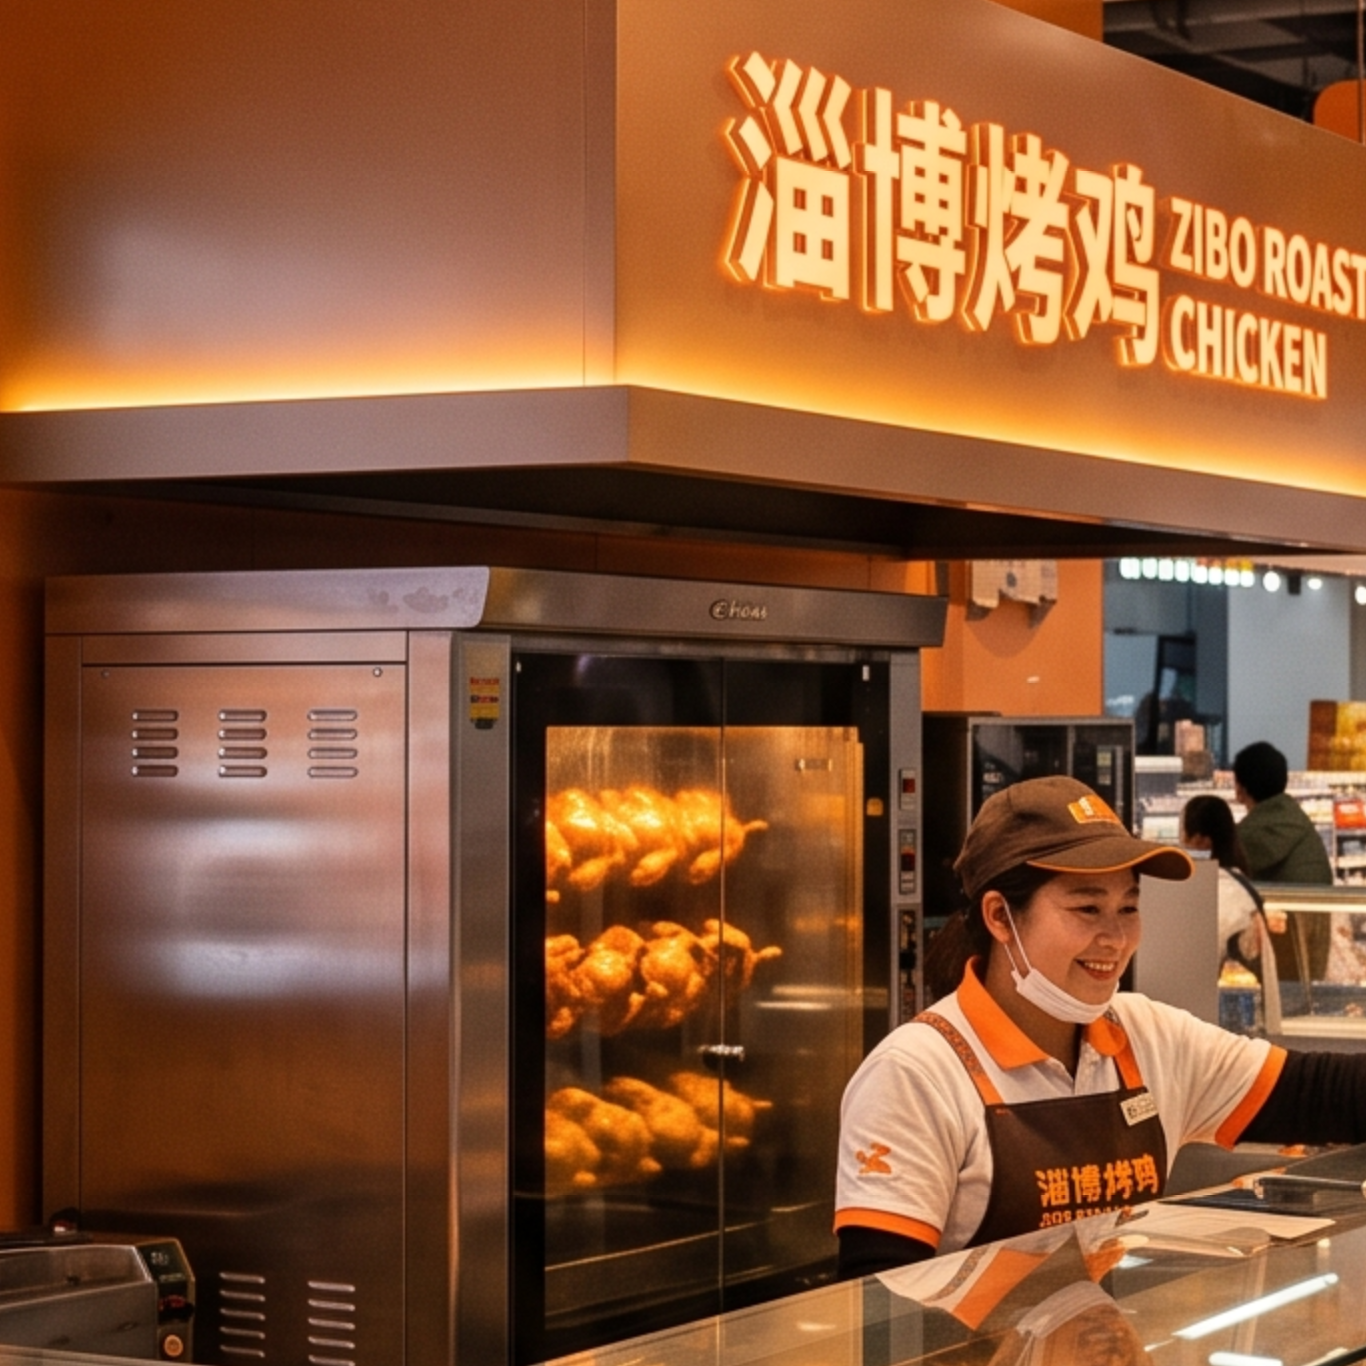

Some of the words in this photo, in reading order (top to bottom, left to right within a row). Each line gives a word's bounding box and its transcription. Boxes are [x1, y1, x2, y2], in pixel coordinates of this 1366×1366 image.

[729, 50, 1160, 366] 淄博烤鸡
[1169, 196, 1257, 289] ZIBO
[1167, 293, 1328, 400] CHICKEN
